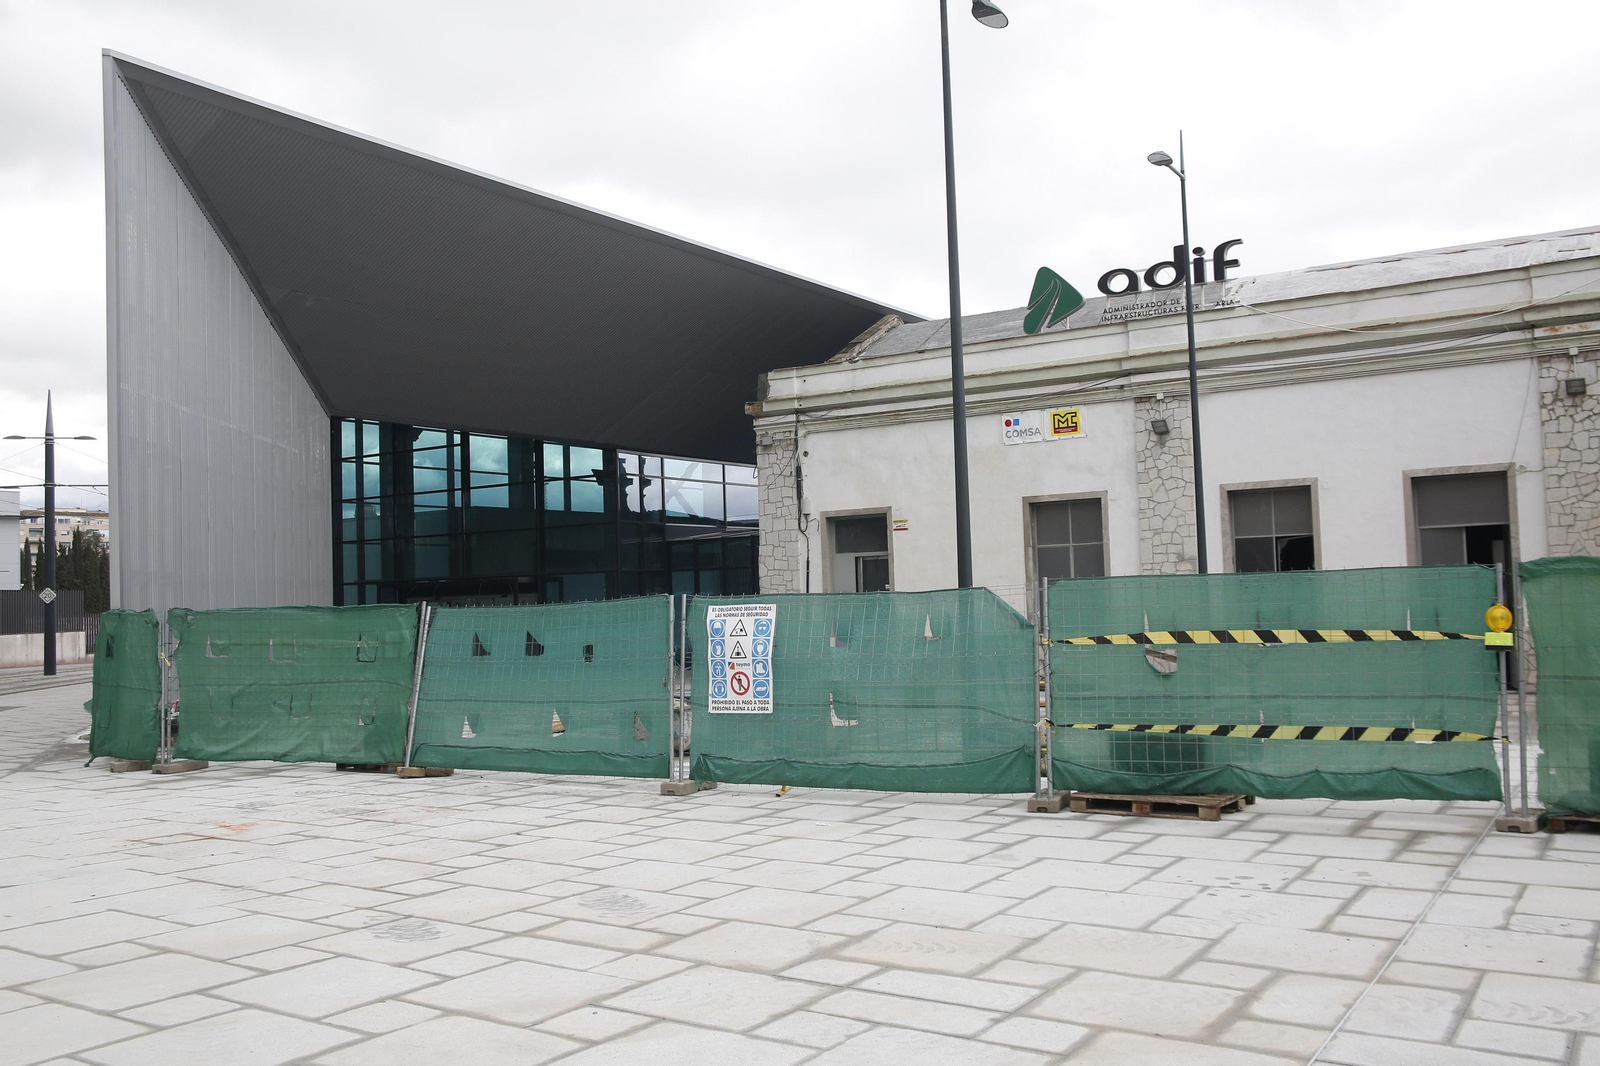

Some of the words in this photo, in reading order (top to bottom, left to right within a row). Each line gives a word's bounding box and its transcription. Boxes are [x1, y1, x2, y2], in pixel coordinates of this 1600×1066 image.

[1097, 238, 1244, 297] adif
[1101, 306, 1179, 322] INFRAESTRUCTURAS
[1102, 300, 1168, 314] ADMINISTRADOR
[1171, 298, 1181, 306] DE
[1005, 427, 1042, 439] COMSA
